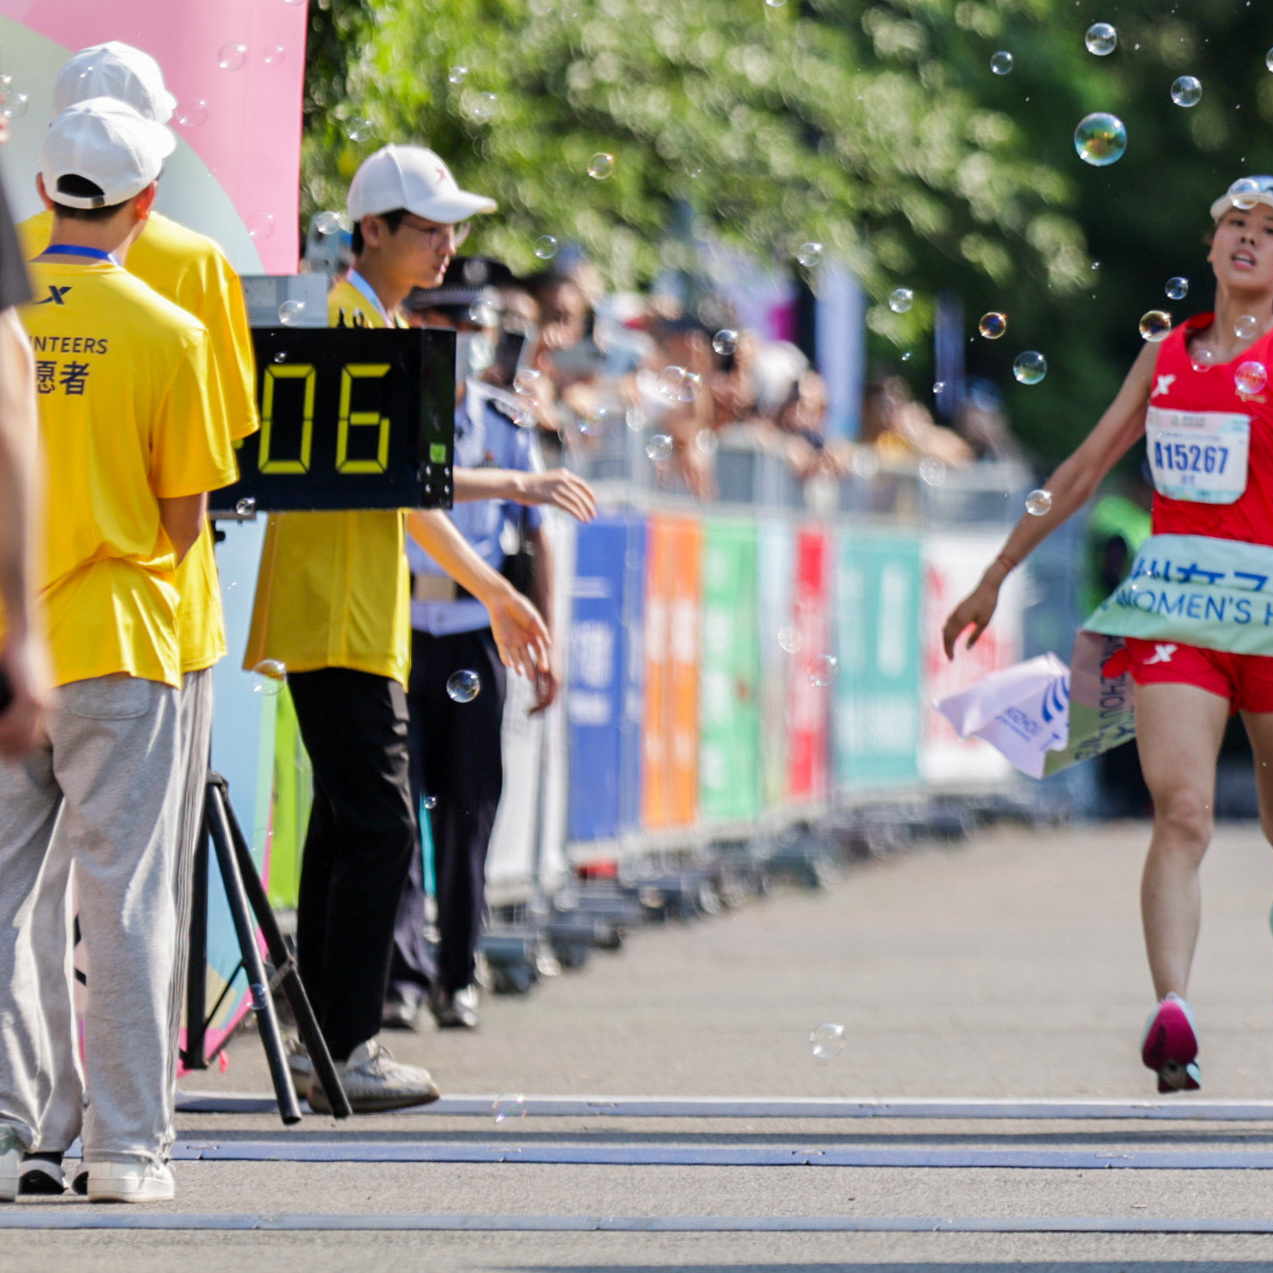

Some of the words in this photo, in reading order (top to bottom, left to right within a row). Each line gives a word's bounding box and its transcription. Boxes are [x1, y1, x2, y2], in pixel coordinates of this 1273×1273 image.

[28, 335, 109, 355] NTEERS
[34, 360, 90, 396] 愿者
[257, 363, 392, 475] 06
